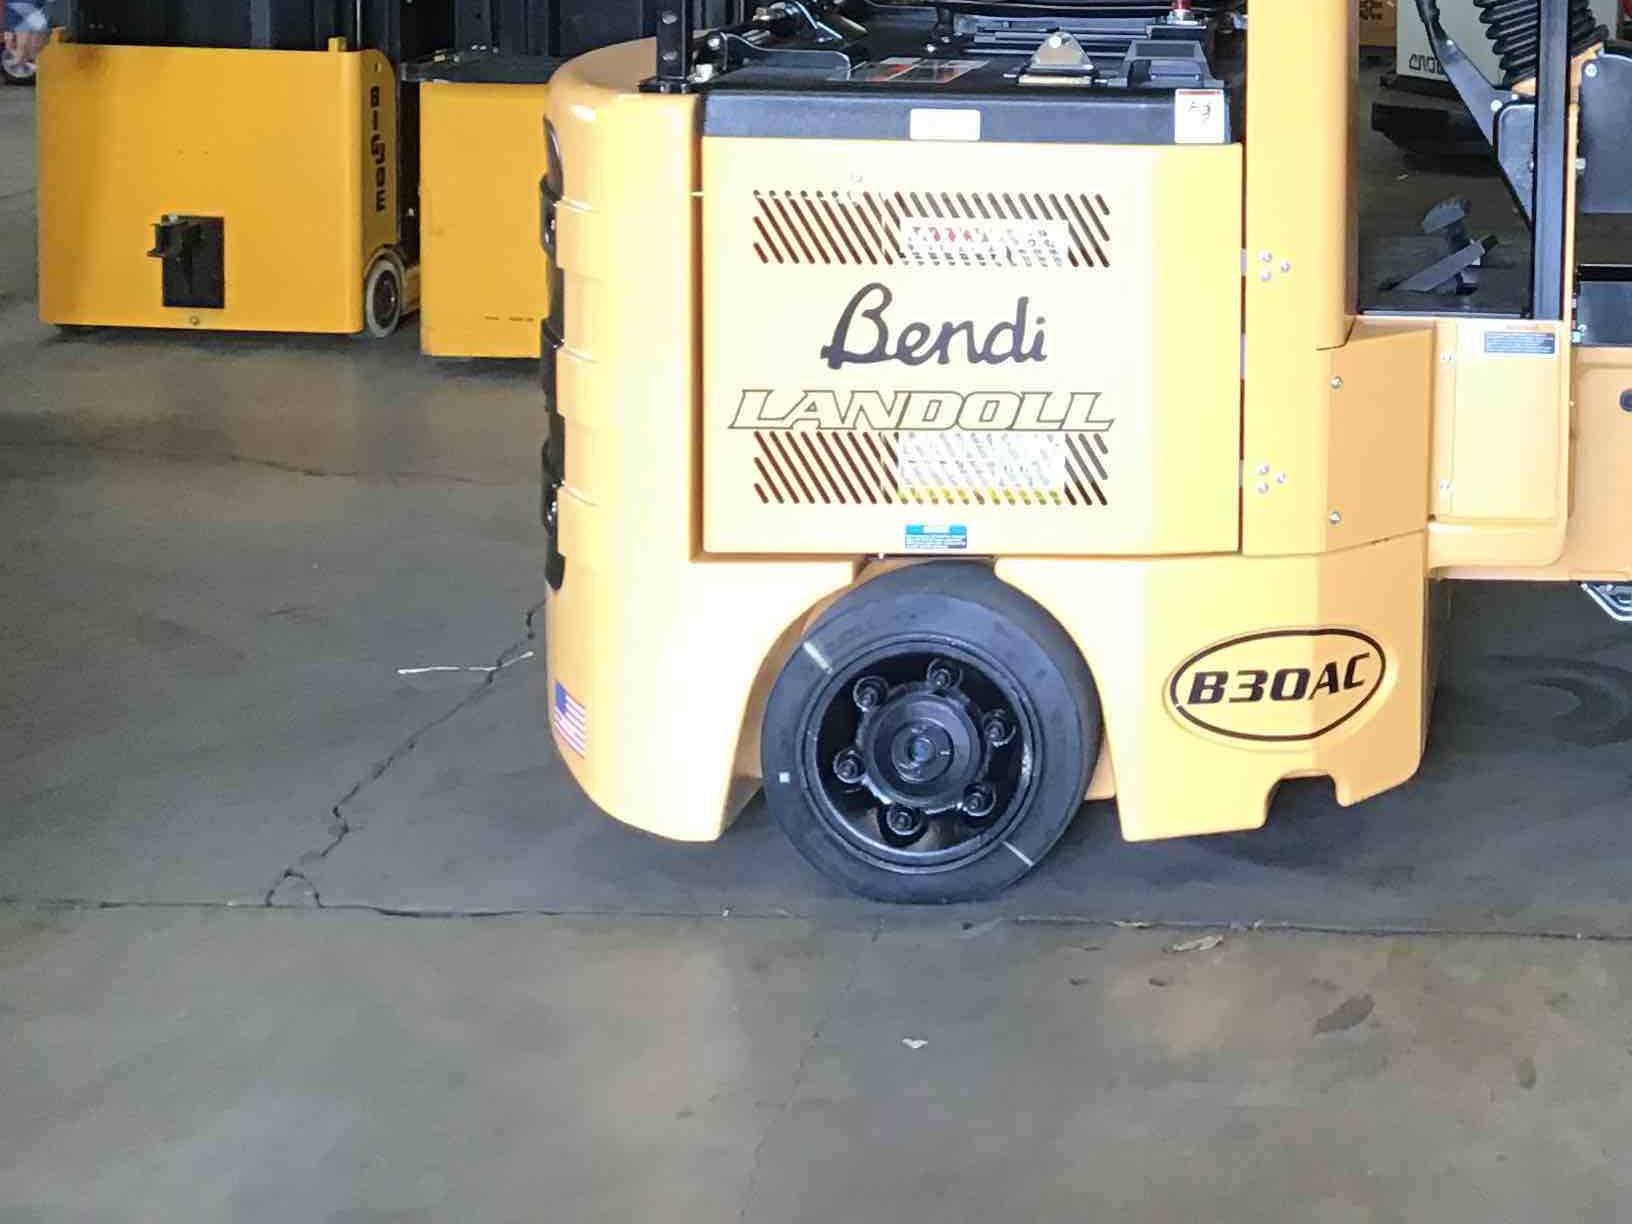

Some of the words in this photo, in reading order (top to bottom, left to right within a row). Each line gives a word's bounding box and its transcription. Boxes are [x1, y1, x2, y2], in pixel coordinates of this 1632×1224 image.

[820, 282, 1048, 370] Bendi
[728, 388, 1115, 432] LANDOLL
[1187, 652, 1370, 705] B30AC
